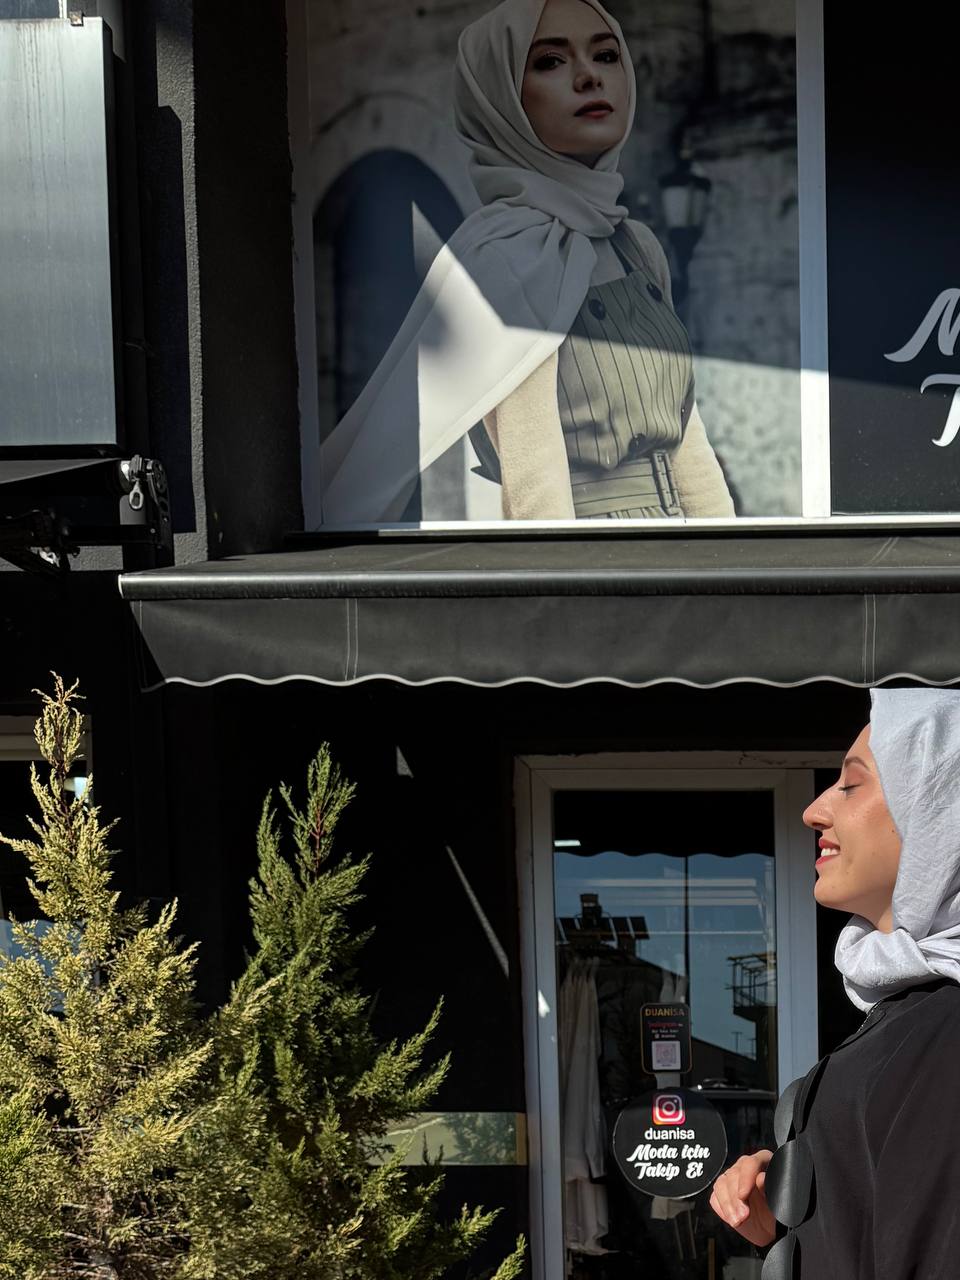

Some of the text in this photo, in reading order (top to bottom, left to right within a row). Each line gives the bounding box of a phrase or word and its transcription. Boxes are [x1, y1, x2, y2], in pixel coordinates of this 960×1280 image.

[644, 1127, 695, 1140] duanisa
[626, 1144, 711, 1162] Moda için
[634, 1161, 704, 1181] Takip Et
